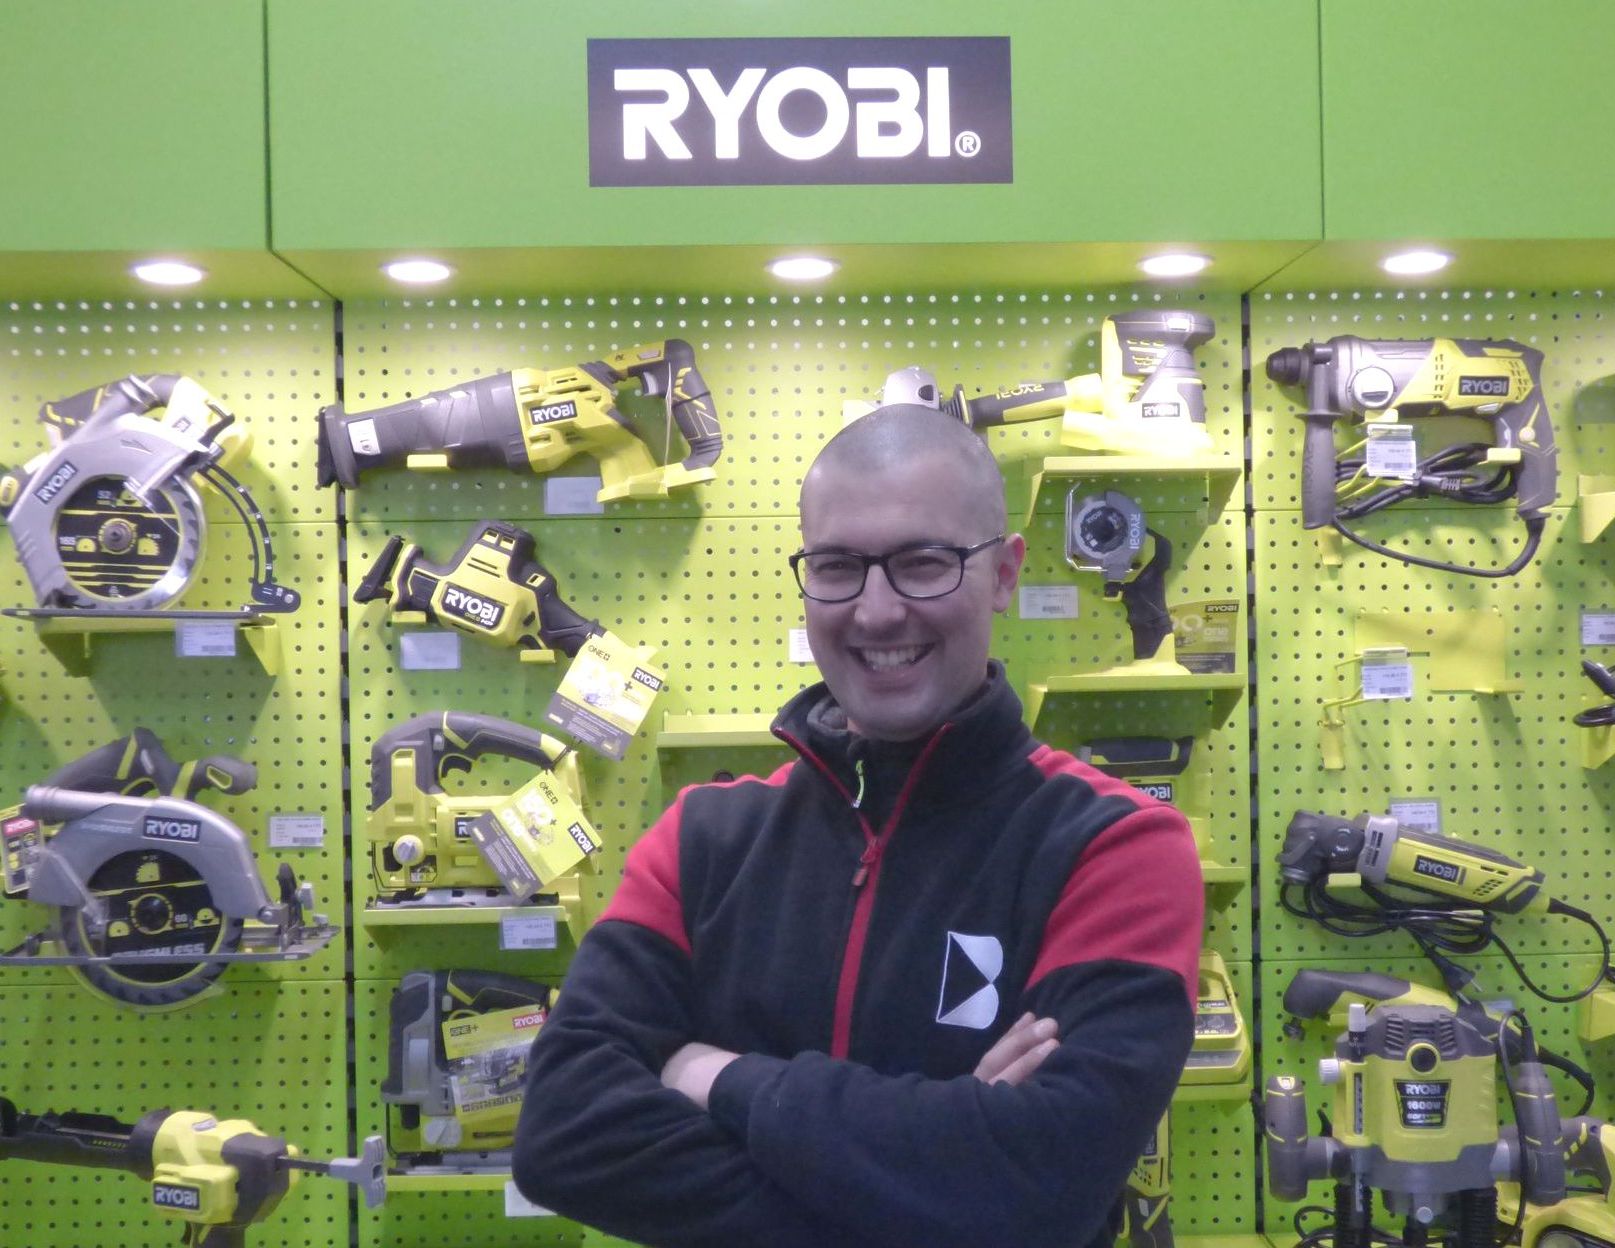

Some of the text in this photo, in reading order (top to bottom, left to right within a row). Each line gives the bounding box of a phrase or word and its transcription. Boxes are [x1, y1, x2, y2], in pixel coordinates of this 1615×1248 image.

[614, 66, 951, 160] RYOBI
[1461, 379, 1507, 394] RYOBI
[532, 403, 575, 422] RYOBI
[36, 463, 77, 502] RYOBI
[1129, 513, 1141, 550] RYOBI
[445, 588, 500, 622] RYOBI
[633, 669, 660, 690] RYOBI
[146, 819, 198, 839] RYOBI
[570, 824, 594, 853] RYOBI
[1418, 859, 1457, 880] RYOBI
[514, 1014, 544, 1028] RYOBI
[1405, 1084, 1440, 1095] RYOBI
[155, 1187, 198, 1207] RYOBI
